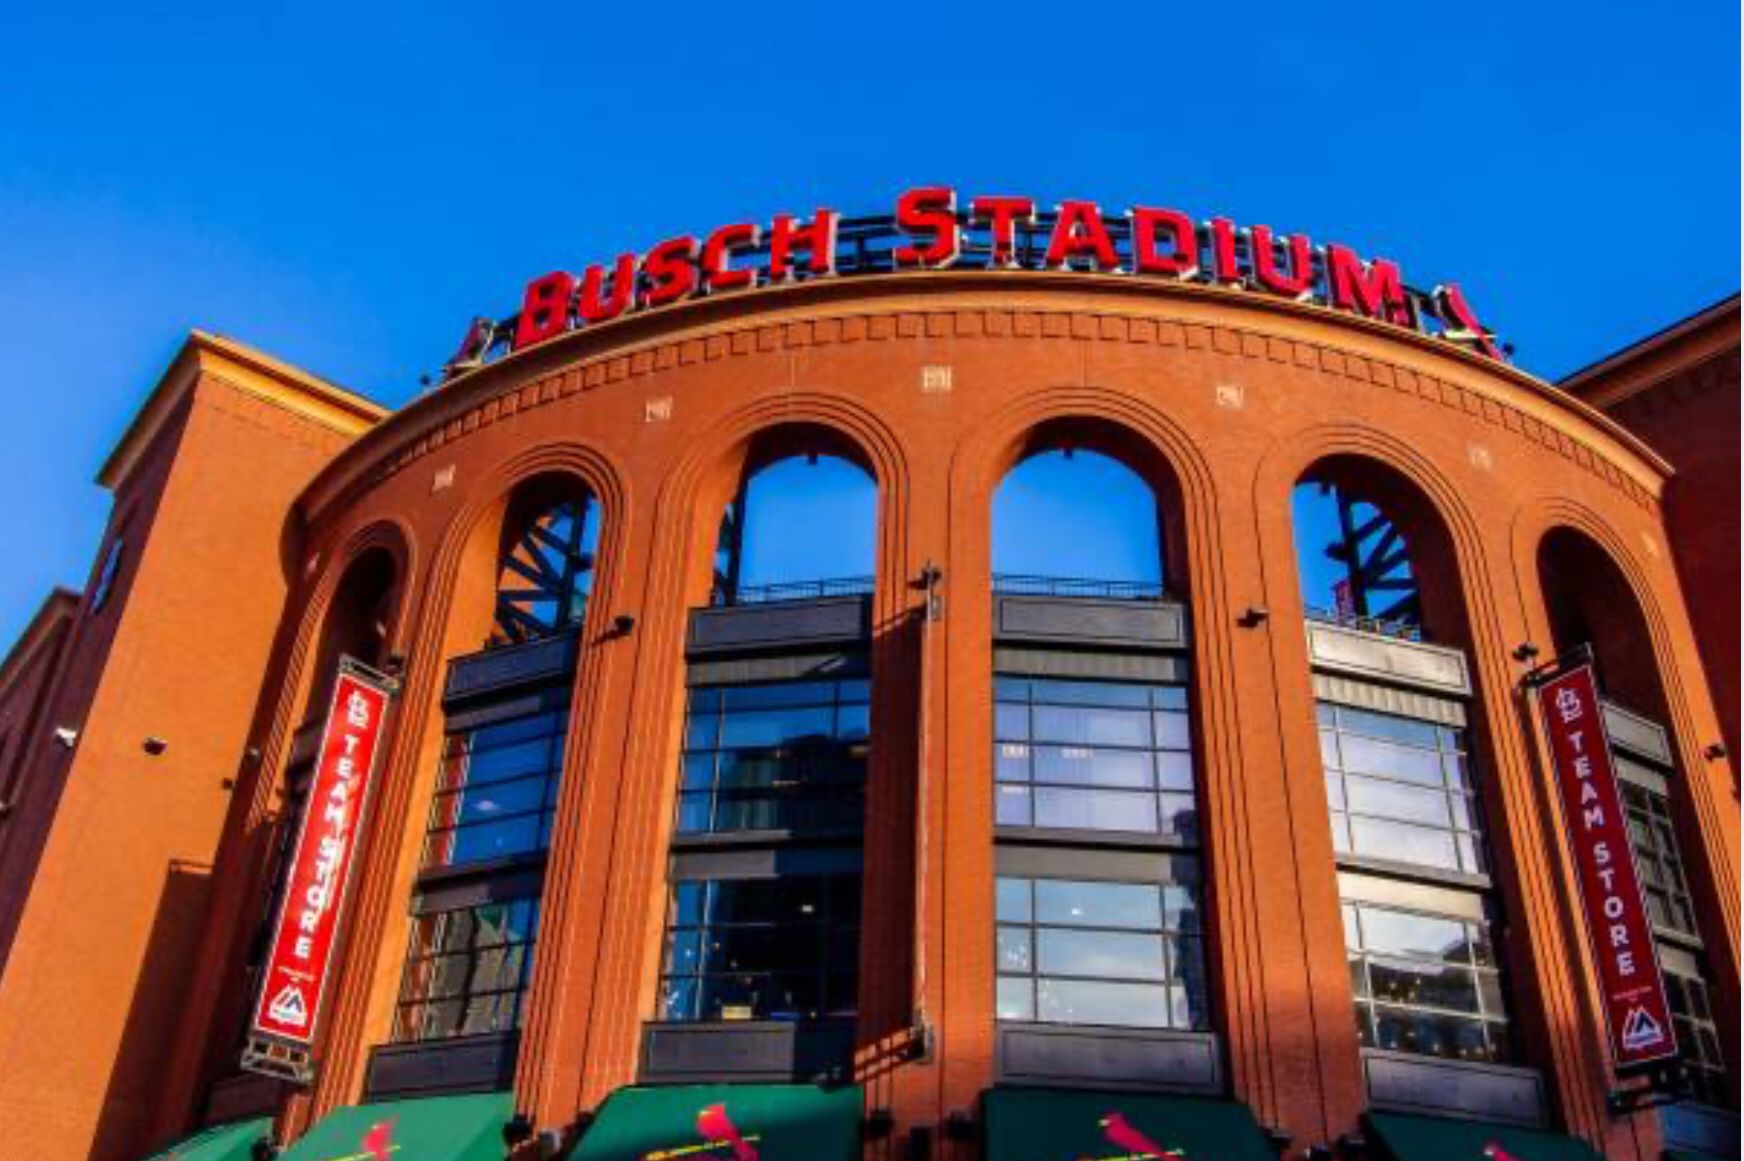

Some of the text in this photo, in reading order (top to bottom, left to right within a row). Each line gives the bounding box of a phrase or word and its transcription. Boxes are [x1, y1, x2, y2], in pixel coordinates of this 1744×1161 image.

[513, 186, 1410, 350] BUSCH STADIUM
[324, 733, 359, 823] TEAM
[294, 835, 338, 959] STORE
[1559, 731, 1605, 830] TEAM
[1593, 842, 1635, 976] STORE
